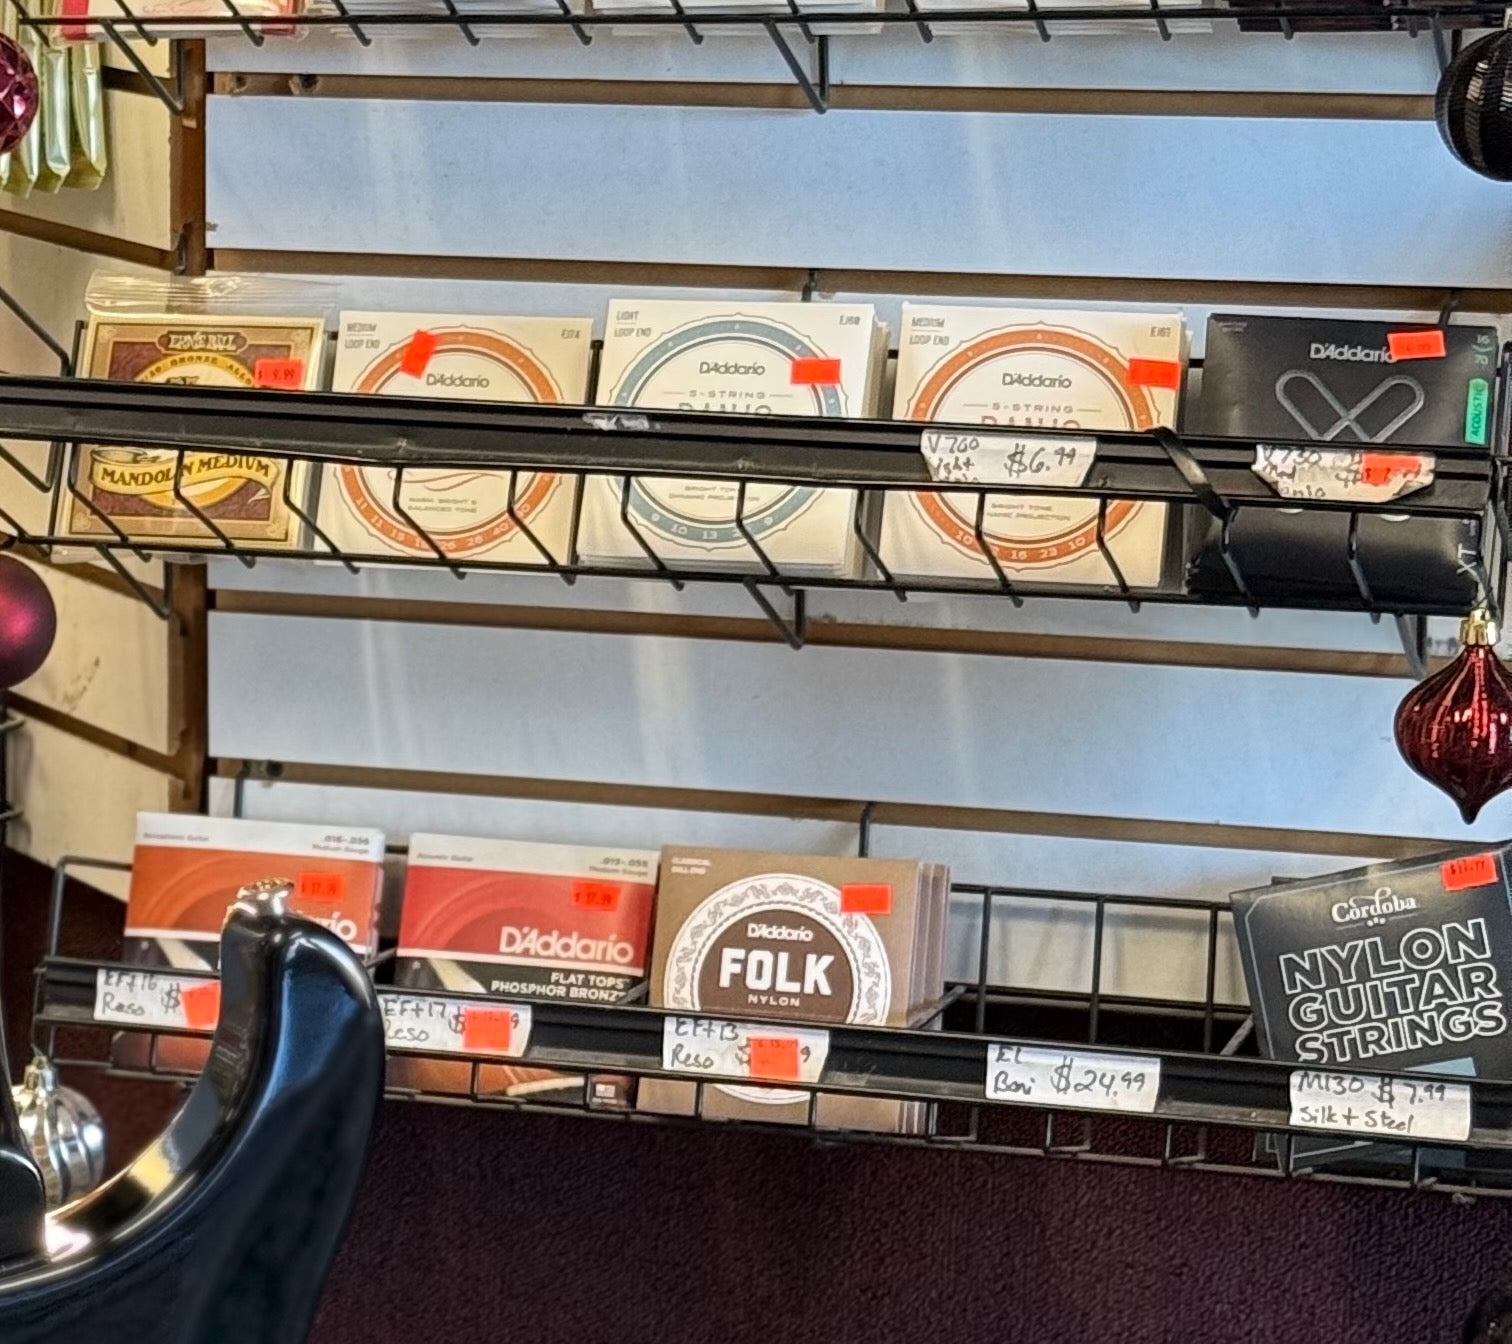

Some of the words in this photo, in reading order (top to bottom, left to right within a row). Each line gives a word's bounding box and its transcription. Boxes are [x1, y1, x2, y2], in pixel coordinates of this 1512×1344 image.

[169, 354, 219, 367] BRONZE
[227, 363, 253, 386] ALLO
[699, 361, 766, 376] D'Addario
[426, 372, 490, 389] D'Addario
[1001, 371, 1073, 390] D'Addario
[100, 462, 194, 487] MANDOLN
[197, 455, 271, 478] MEDIUM
[491, 523, 510, 536] 40
[670, 523, 688, 535] 10
[701, 530, 718, 540] 13
[957, 530, 973, 545] 10
[1067, 536, 1086, 551] 10
[1456, 542, 1478, 577] XT
[746, 921, 814, 942] D'Addario
[499, 925, 635, 964] D'Addario
[1279, 917, 1492, 995] NYLON
[550, 971, 586, 986] FLAT
[588, 975, 626, 990] TOPS
[718, 947, 835, 996] FOLK
[490, 980, 567, 998] PHOSPHOR
[1288, 961, 1503, 1032] GUITAR
[747, 993, 801, 1008] NYLON
[1294, 1000, 1507, 1064] STRINGS
[670, 1043, 715, 1069] Reso
[1050, 1054, 1146, 1097] $24.99
[1299, 1104, 1339, 1124] Silk
[1364, 1109, 1415, 1134] Steel
